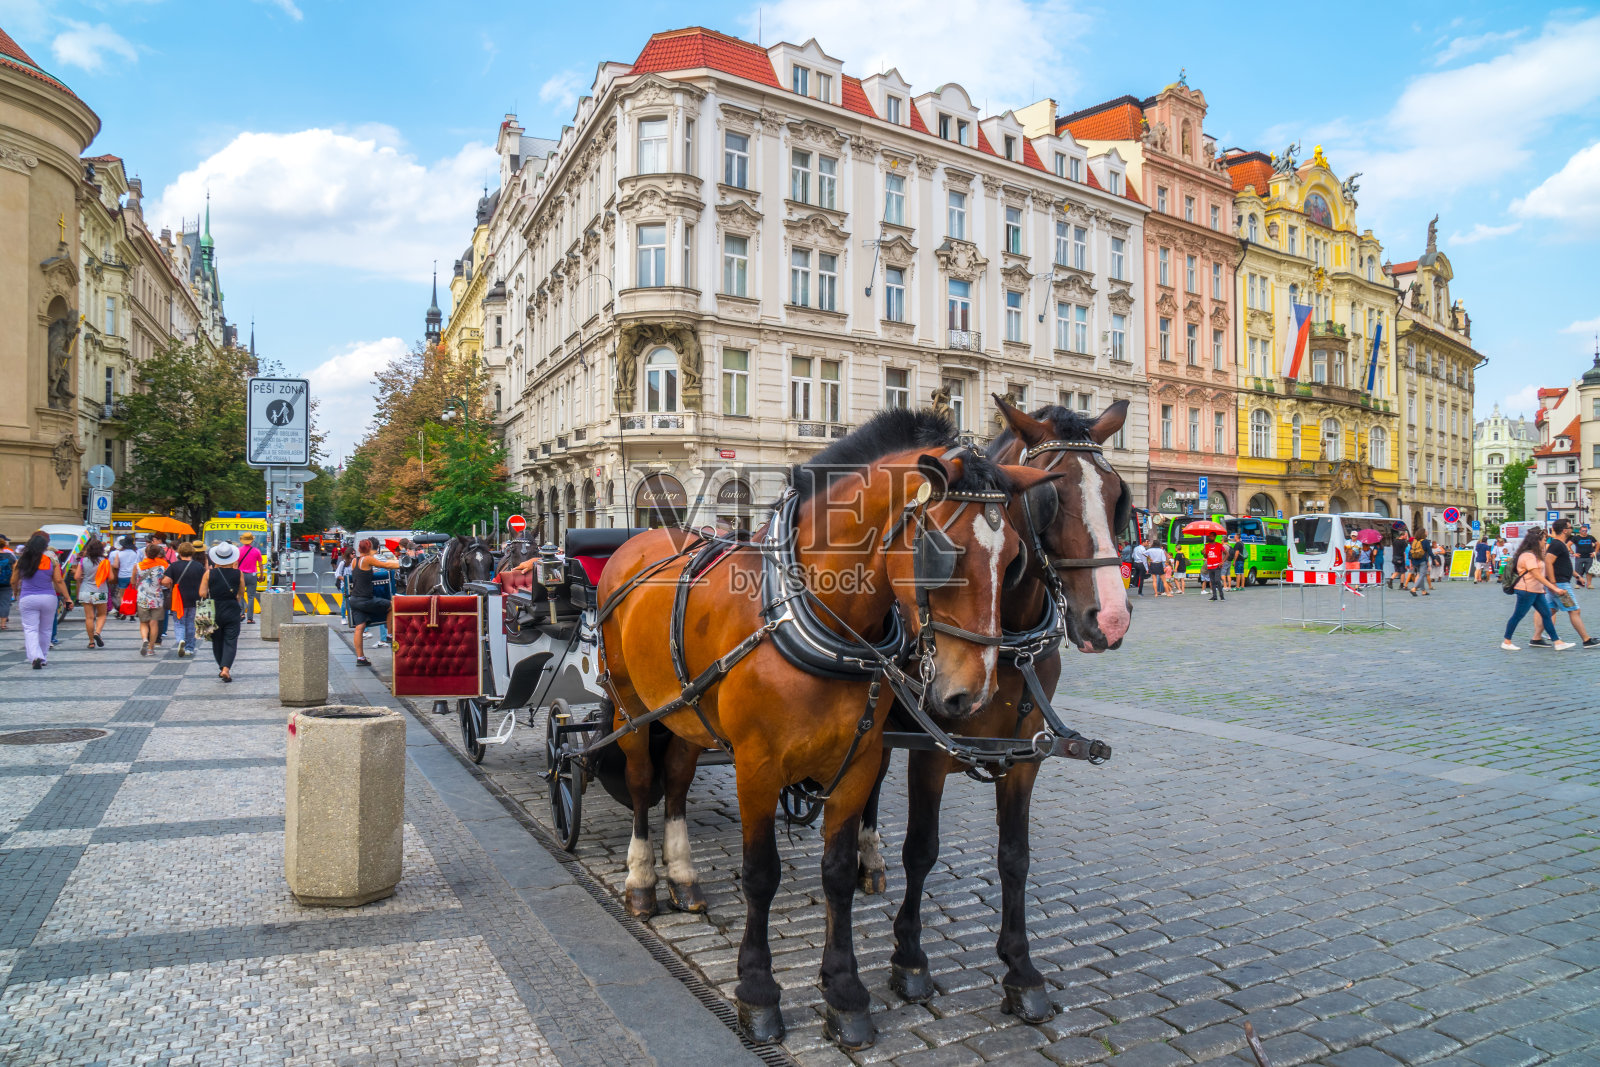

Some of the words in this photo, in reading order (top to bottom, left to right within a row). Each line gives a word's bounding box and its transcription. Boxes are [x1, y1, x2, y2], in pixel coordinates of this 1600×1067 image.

[253, 383, 275, 394] PĚŠÍ
[279, 383, 305, 394] ZÓNA
[1200, 479, 1206, 493] P
[643, 491, 680, 501] Cartier
[720, 488, 748, 499] Cartier
[234, 523, 265, 531] TOURS
